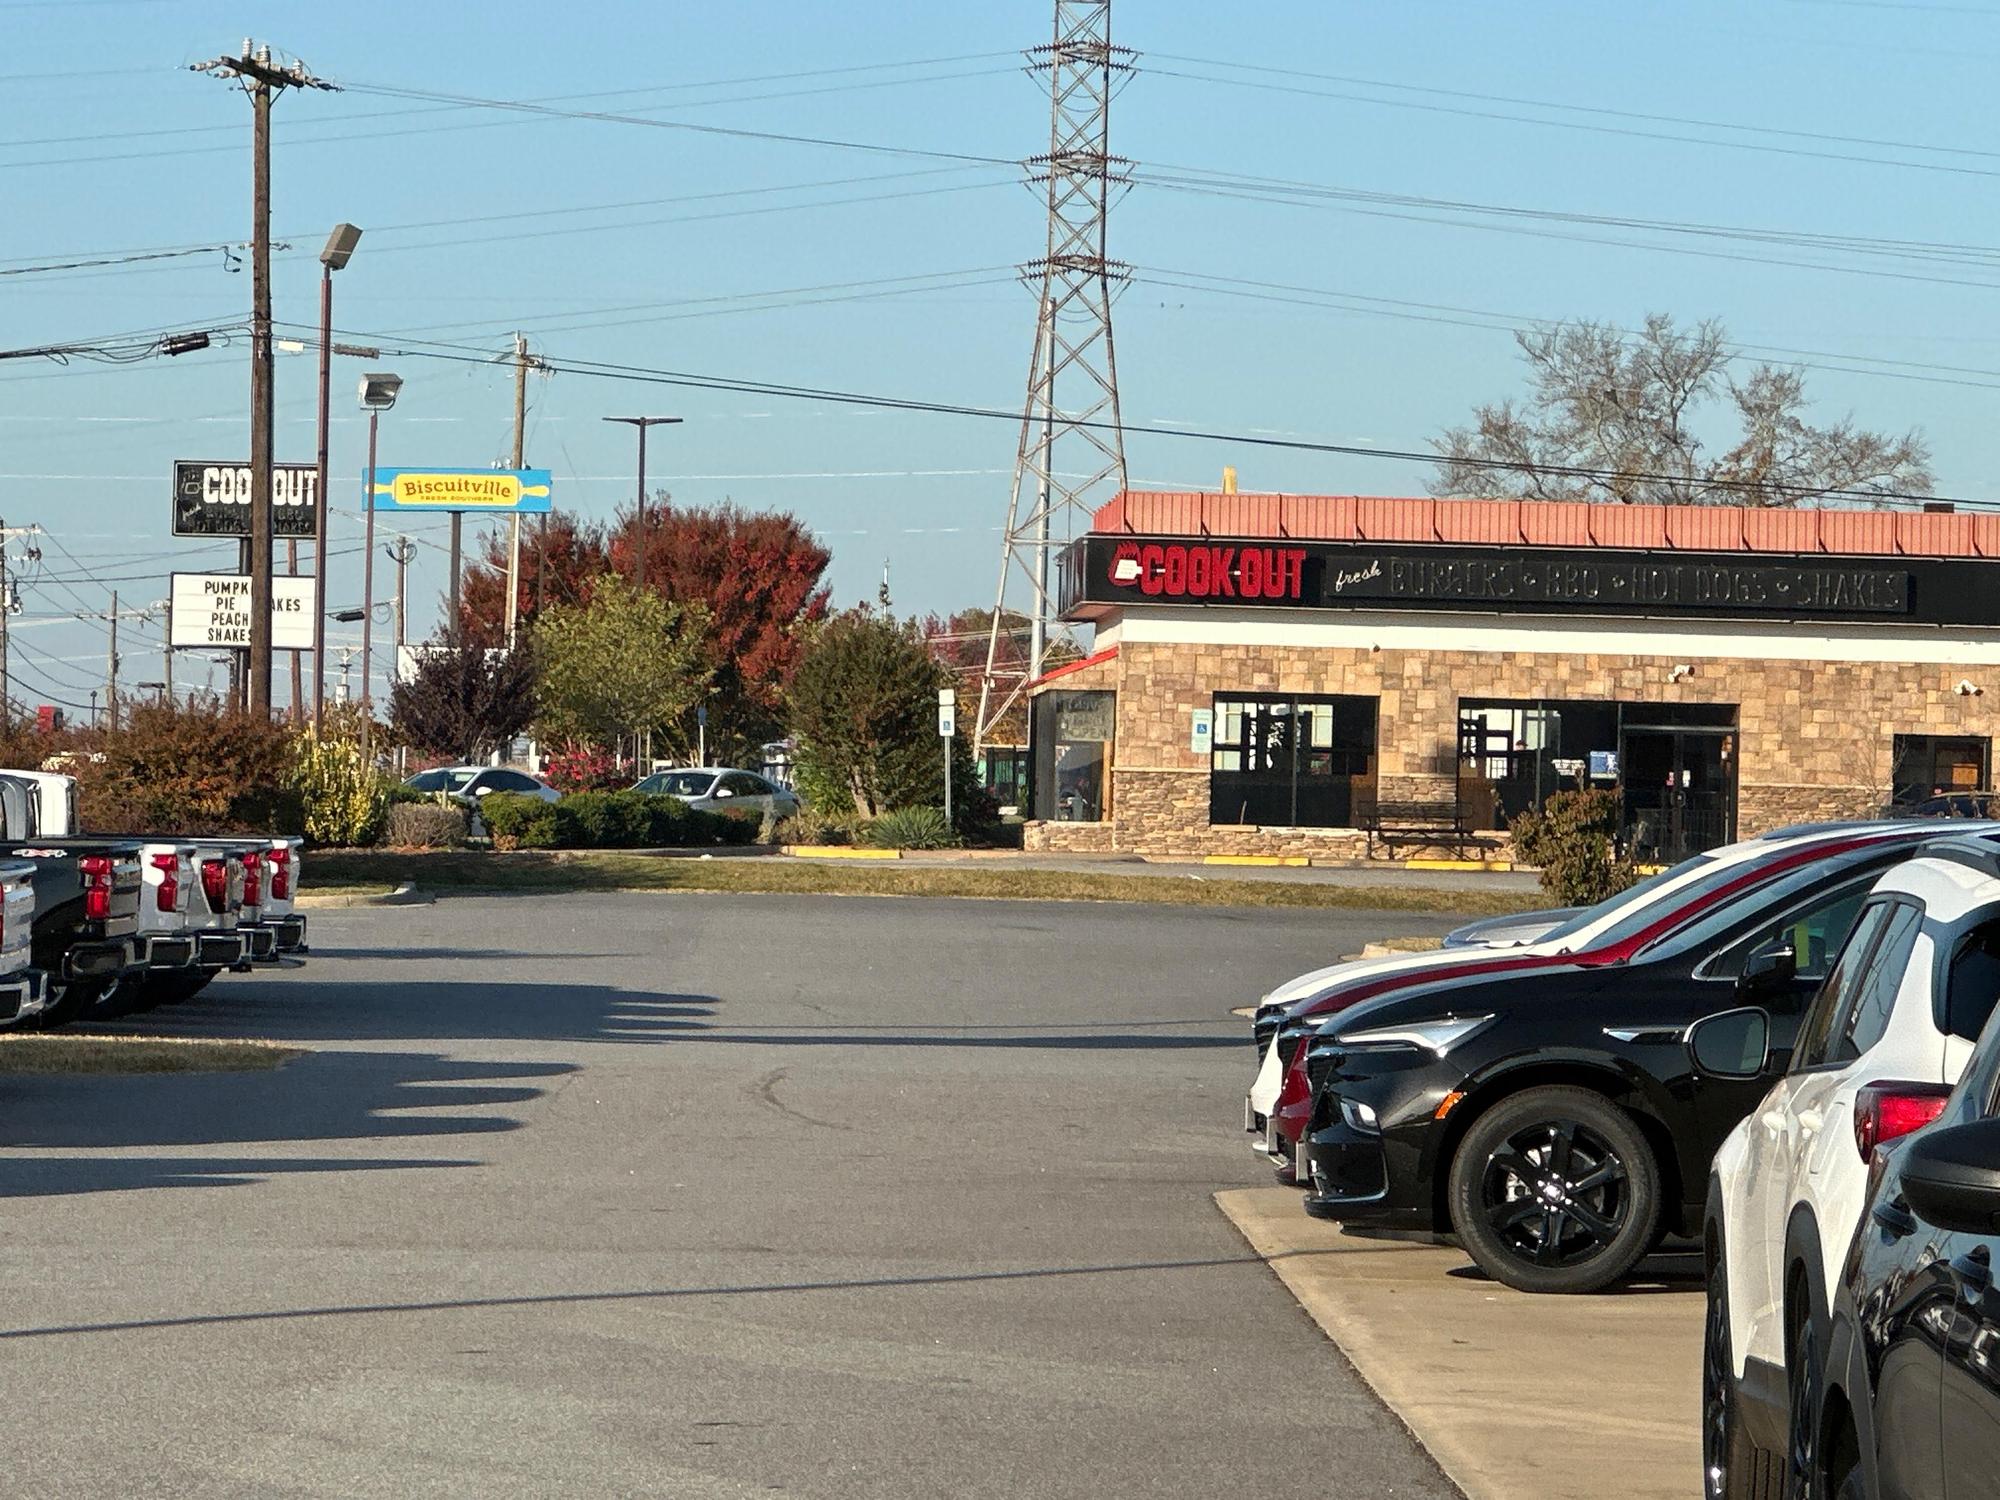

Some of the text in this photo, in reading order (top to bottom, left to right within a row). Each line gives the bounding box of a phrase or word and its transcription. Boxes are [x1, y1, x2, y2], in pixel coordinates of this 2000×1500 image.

[404, 478, 511, 497] Biscuitville
[205, 581, 253, 594] PUMPK
[1335, 560, 1900, 608] fresh BURGERS BBQ HOT DOGS SHAKES
[216, 597, 235, 610] PIE
[211, 612, 249, 626] PEACH
